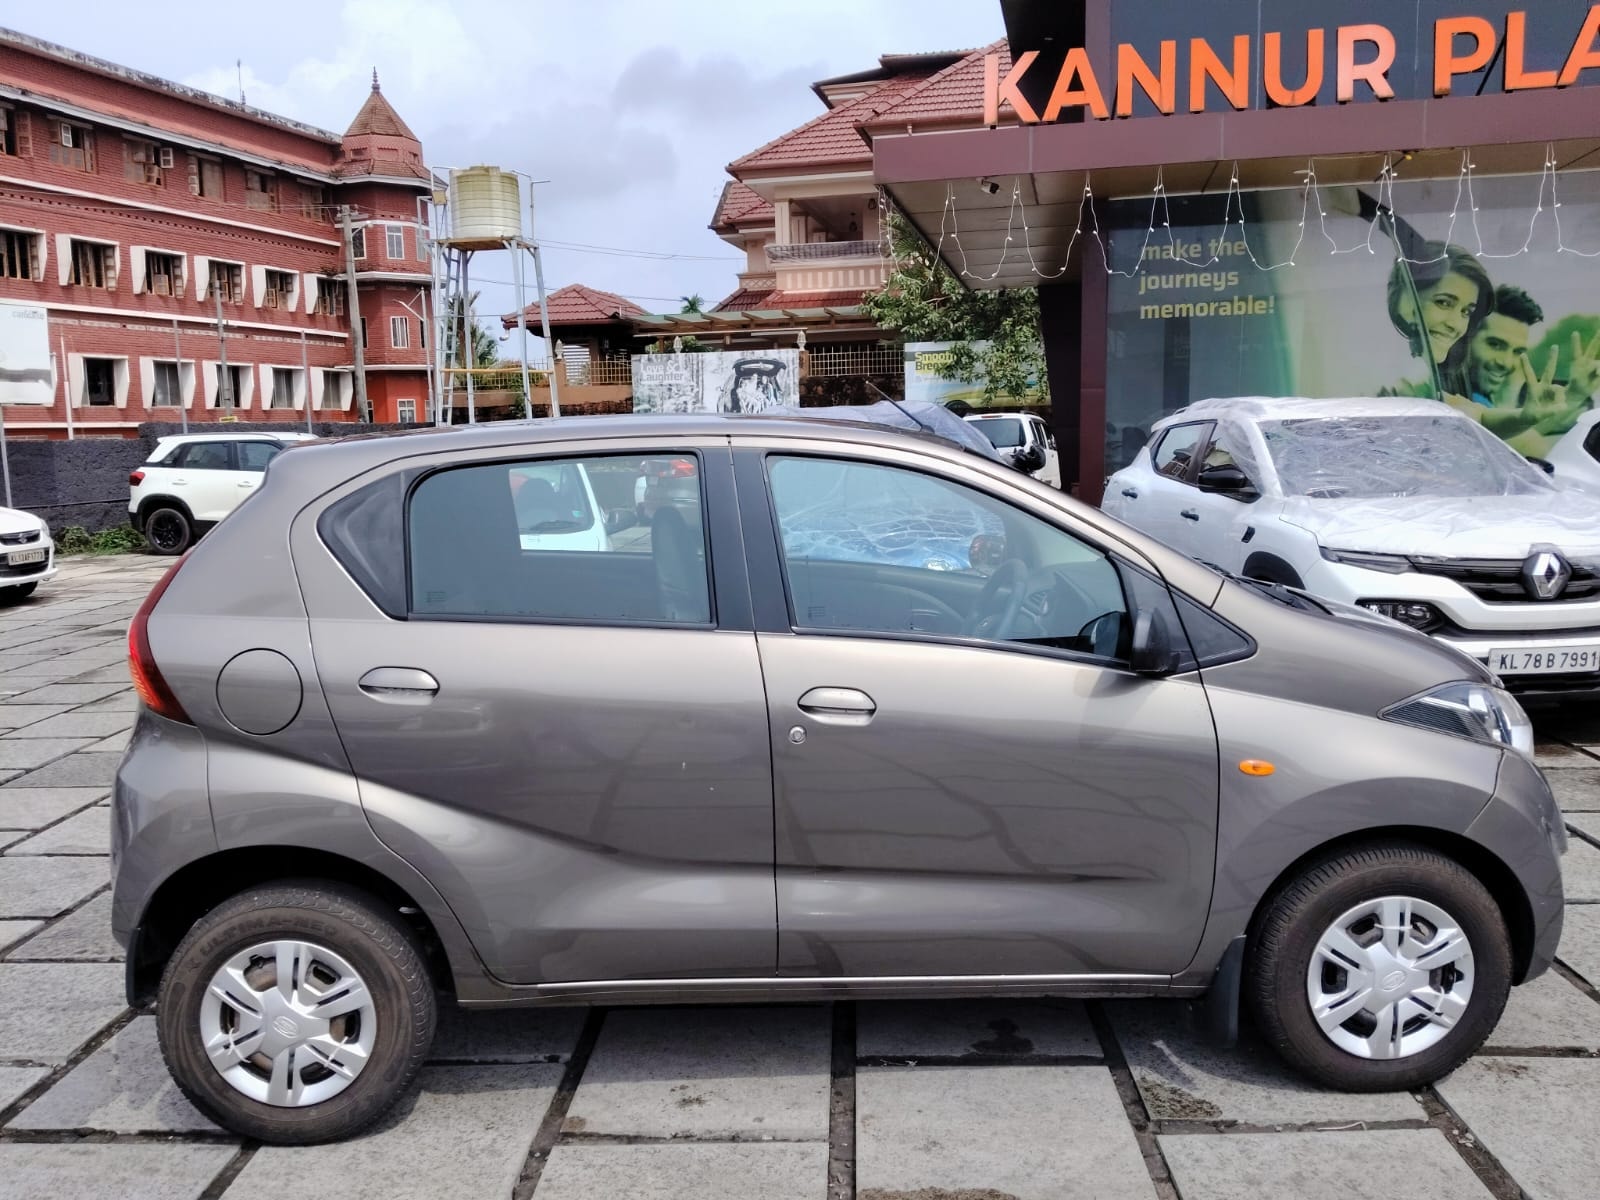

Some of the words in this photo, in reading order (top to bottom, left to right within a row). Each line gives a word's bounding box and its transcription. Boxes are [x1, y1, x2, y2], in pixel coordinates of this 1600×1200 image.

[984, 24, 1397, 127] KANNUR
[1433, 3, 1600, 97] PLA
[1141, 239, 1202, 260] make
[1208, 238, 1246, 258] the
[1138, 270, 1240, 294] journeys
[1140, 294, 1275, 319] memorable!
[1499, 653, 1518, 670] KL
[1523, 653, 1543, 669] 78
[1546, 652, 1556, 669] B
[1560, 651, 1597, 668] 7991
